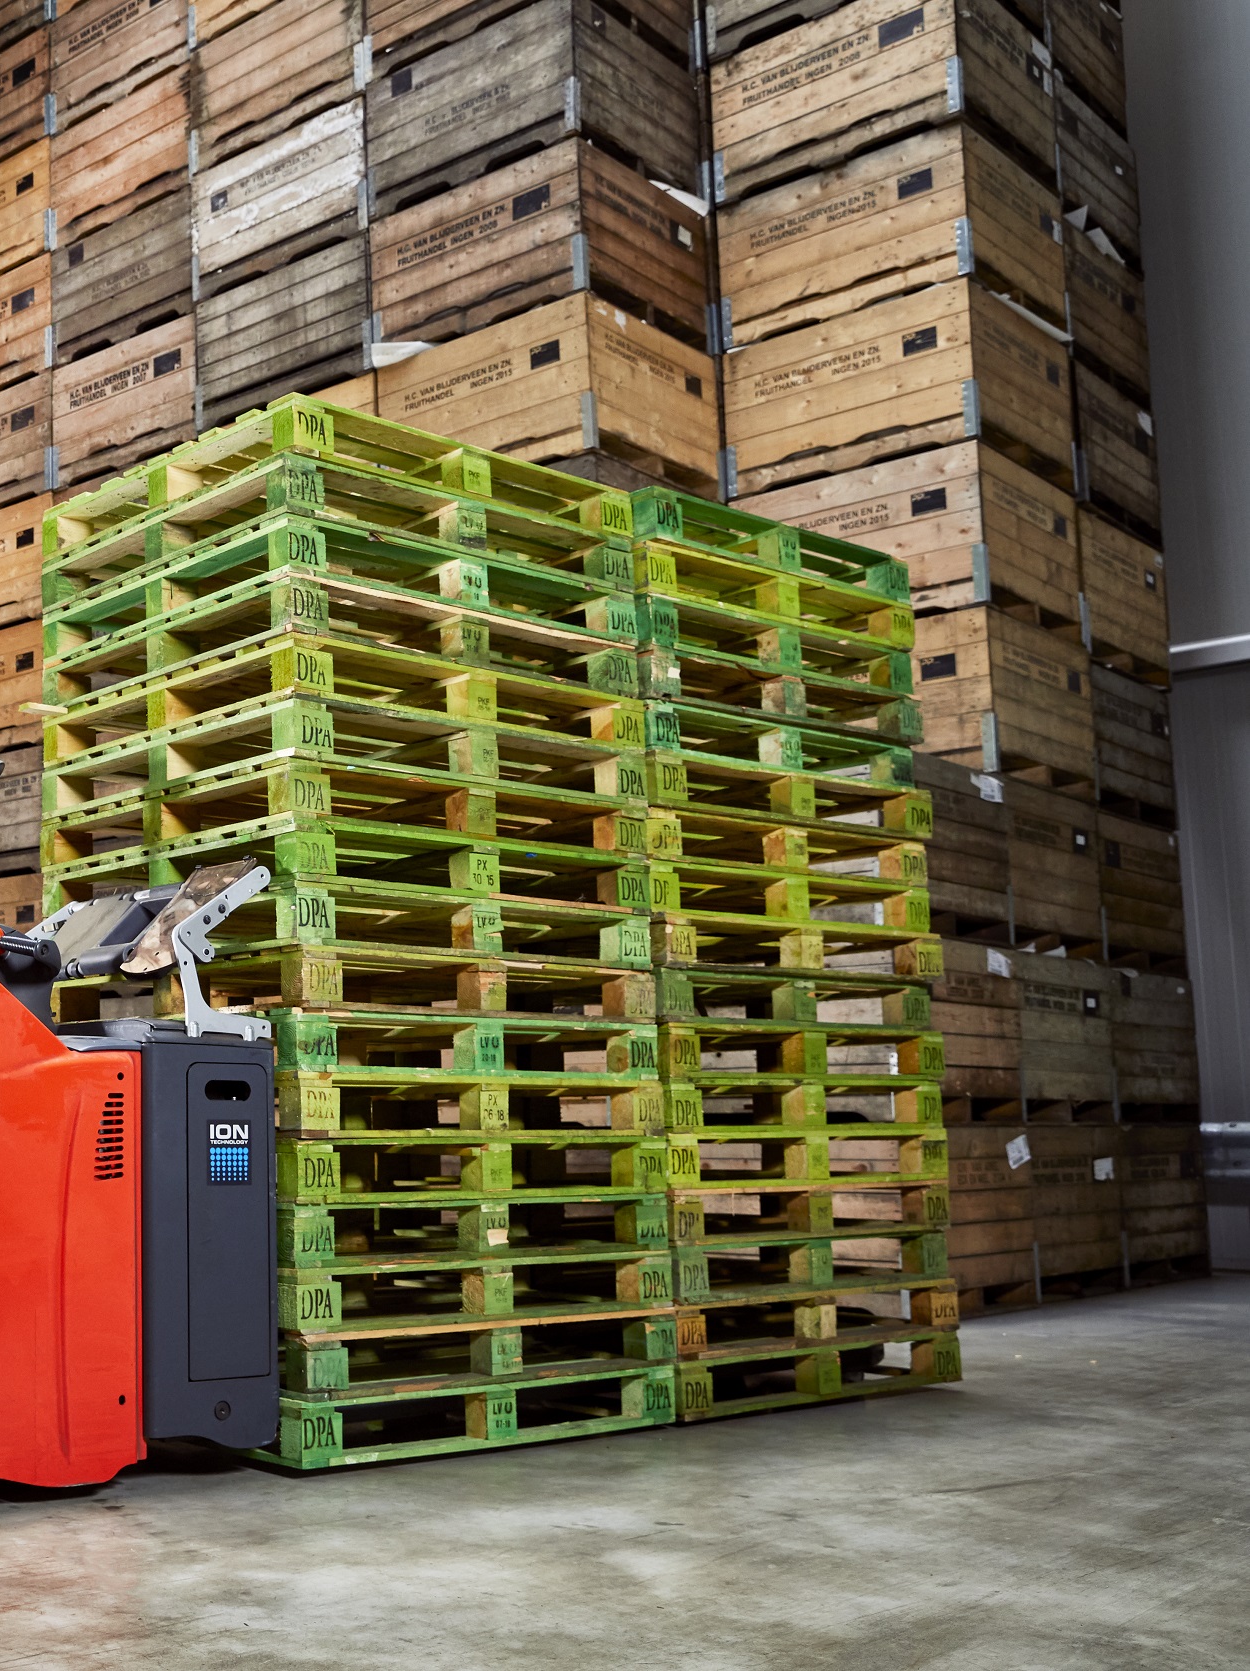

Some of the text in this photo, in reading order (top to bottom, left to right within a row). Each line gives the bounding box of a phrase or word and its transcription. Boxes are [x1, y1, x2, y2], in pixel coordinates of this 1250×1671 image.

[761, 74, 778, 85] VAN
[779, 47, 839, 78] BLIJDERVEEN
[841, 40, 854, 52] EN
[742, 63, 832, 105] FRUITHANDEL INGEN
[413, 238, 429, 249] VAN
[429, 214, 481, 243] BLIJDERVEEN
[482, 209, 493, 221] EN
[750, 200, 877, 249] FRUITHANDEL INGEN 2015
[768, 223, 786, 234] VAN
[787, 201, 847, 228] BLIJDERVEEN
[848, 195, 861, 206] EN
[396, 230, 474, 267] FRUITHANDEL INGEN
[81, 383, 93, 395] VAN
[93, 369, 130, 391] BLIJDERVEEN
[131, 365, 141, 376] EN
[419, 385, 435, 397] VAN
[435, 367, 487, 391] BLIJDERVEEN
[488, 363, 499, 373] EN
[754, 355, 882, 397] FRUITHANDEL INGEN 2015
[772, 373, 791, 383] VAN
[791, 354, 851, 378] BLIJDERVEEN
[852, 350, 866, 360] EN
[70, 388, 107, 410] FRUITHANDEL
[111, 379, 128, 393] INGEN
[404, 368, 513, 412] FRUITHANDEL INGEN 2015
[296, 410, 328, 447] DPA
[468, 470, 481, 479] PKF
[603, 501, 628, 531] DPA
[656, 500, 681, 529] DPA
[798, 507, 874, 530] BLIJDERVEEN EN
[838, 514, 890, 532] INGEN 2015
[288, 532, 320, 566] DPA
[650, 557, 674, 586] DPA
[293, 587, 324, 621] DPA
[610, 605, 636, 635] DPA
[296, 652, 327, 686] DPA
[608, 656, 634, 684] DPA
[477, 697, 490, 705] PKF
[302, 714, 334, 749] DPA
[616, 715, 641, 743] DPA
[654, 716, 680, 743] DPA
[294, 778, 326, 812] DPA
[620, 768, 645, 797] DPA
[910, 806, 933, 833] DPA
[619, 821, 645, 849] DPA
[300, 841, 331, 872] DPA
[477, 859, 487, 871] PX
[620, 877, 647, 903] DPA
[297, 896, 331, 929] DPA
[623, 930, 648, 958] DPA
[308, 962, 340, 996] DPA
[631, 1039, 656, 1068] DPA
[674, 1038, 698, 1066] DPA
[923, 1046, 945, 1072] DPA
[487, 1093, 498, 1106] PX
[675, 1100, 699, 1127] DPA
[209, 1123, 249, 1140] ION
[303, 1157, 336, 1189] DPA
[672, 1148, 697, 1175] DPA
[926, 1195, 949, 1221] DPA
[300, 1223, 335, 1253] DPA
[494, 1288, 508, 1297] PKF
[642, 1270, 669, 1300] DPA
[683, 1263, 708, 1293] DPA
[300, 1288, 334, 1320] DPA
[680, 1320, 706, 1347] DPA
[935, 1350, 959, 1378] DPA
[646, 1382, 673, 1411] DPA
[685, 1381, 710, 1410] DPA
[303, 1415, 337, 1450] DPA
